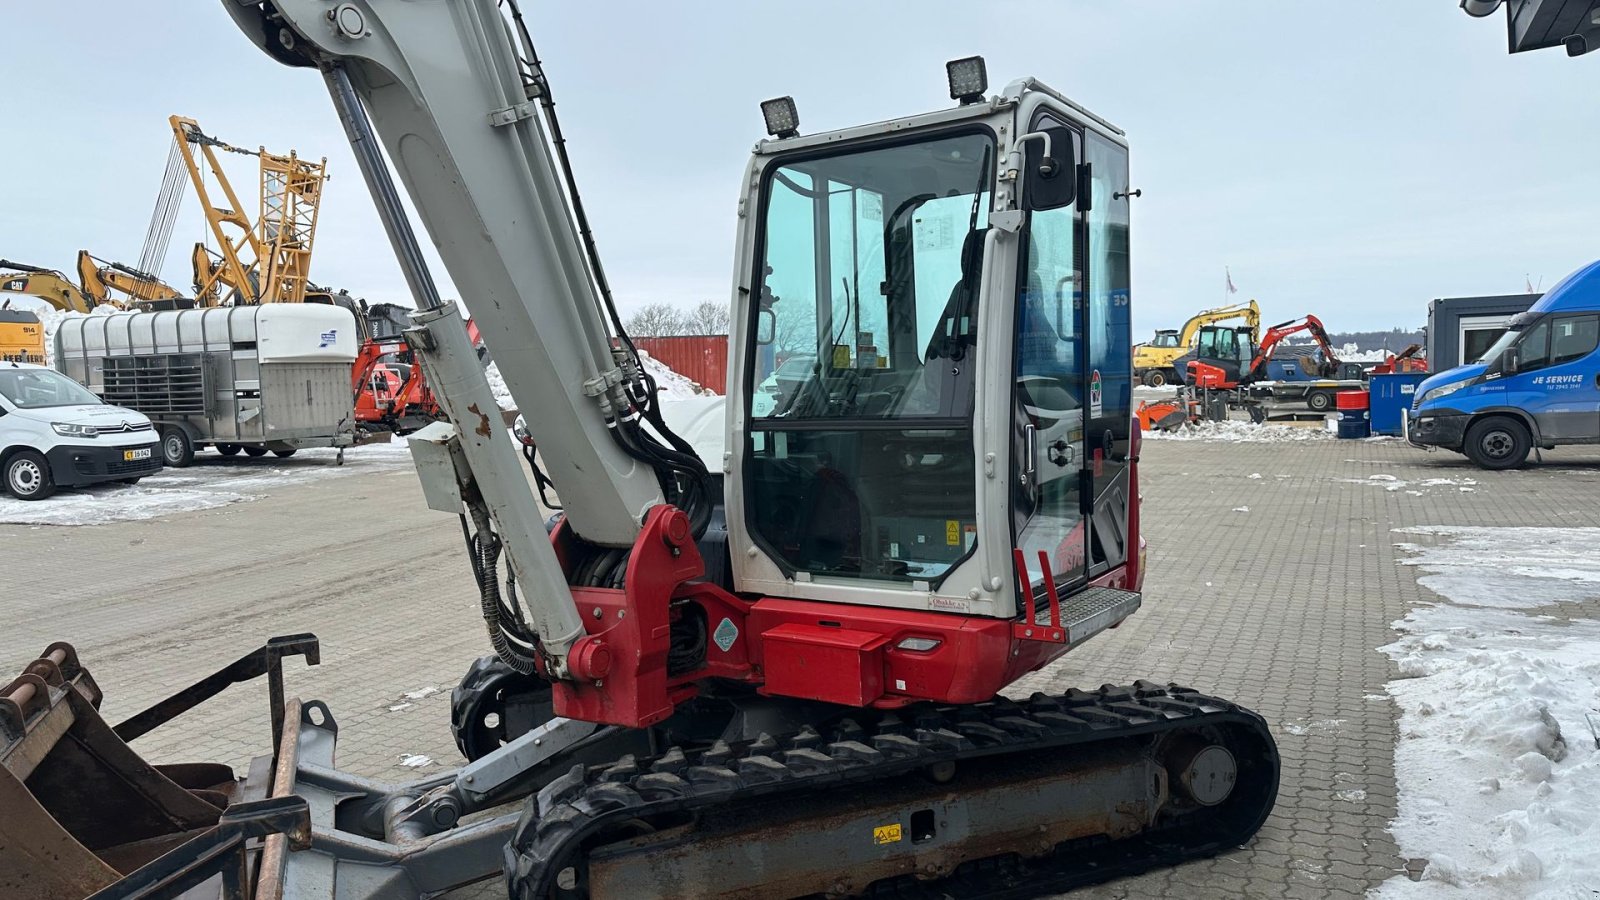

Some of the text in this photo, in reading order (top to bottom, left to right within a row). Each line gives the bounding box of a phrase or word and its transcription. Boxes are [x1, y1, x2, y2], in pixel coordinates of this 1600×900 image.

[11, 281, 23, 290] CAT
[1532, 374, 1584, 385] JE SERVICE
[141, 449, 150, 457] 042
